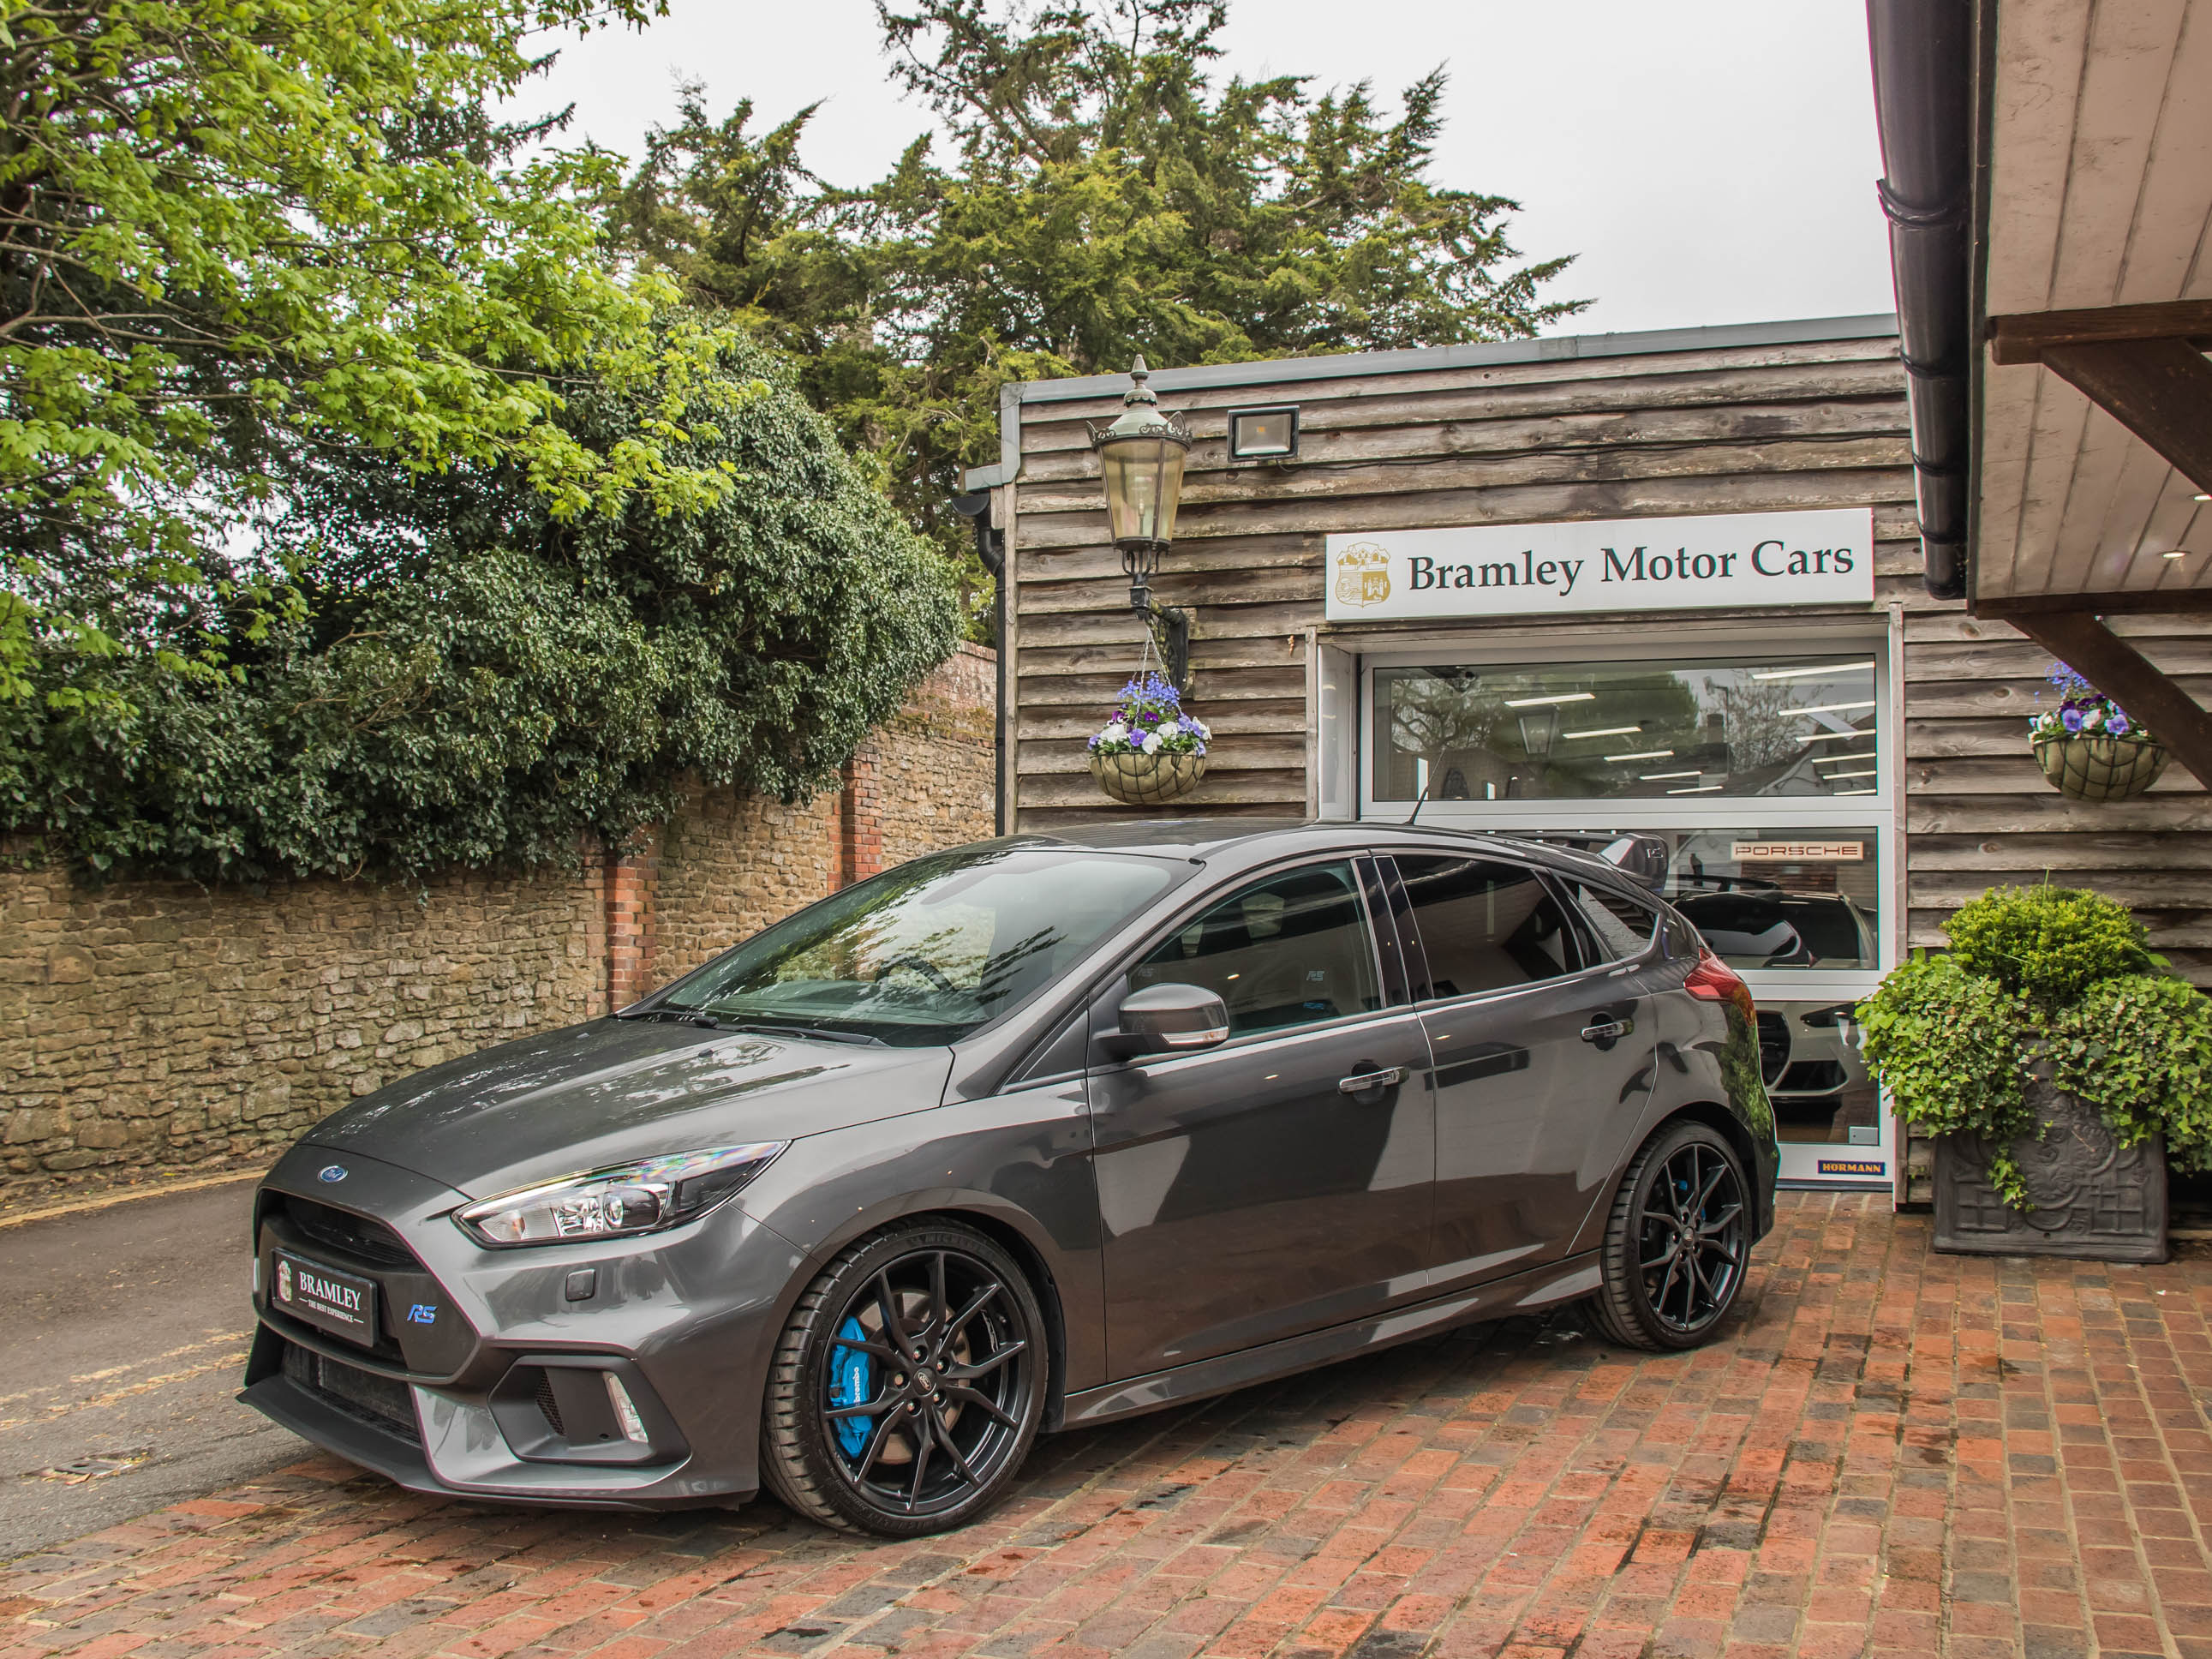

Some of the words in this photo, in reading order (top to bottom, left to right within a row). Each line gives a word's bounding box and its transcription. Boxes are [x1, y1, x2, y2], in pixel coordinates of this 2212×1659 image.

[1407, 549, 1585, 596] Bramley
[1599, 546, 1737, 582] Motor
[1750, 540, 1855, 576] Cars
[1735, 846, 1858, 856] PORSCHE
[298, 1271, 361, 1311] BRAMLEY
[308, 1299, 317, 1309] THE
[317, 1303, 327, 1314] BEST
[327, 1306, 354, 1323] EXPERIENCE
[406, 1303, 438, 1324] RS
[852, 1366, 861, 1403] brembo
